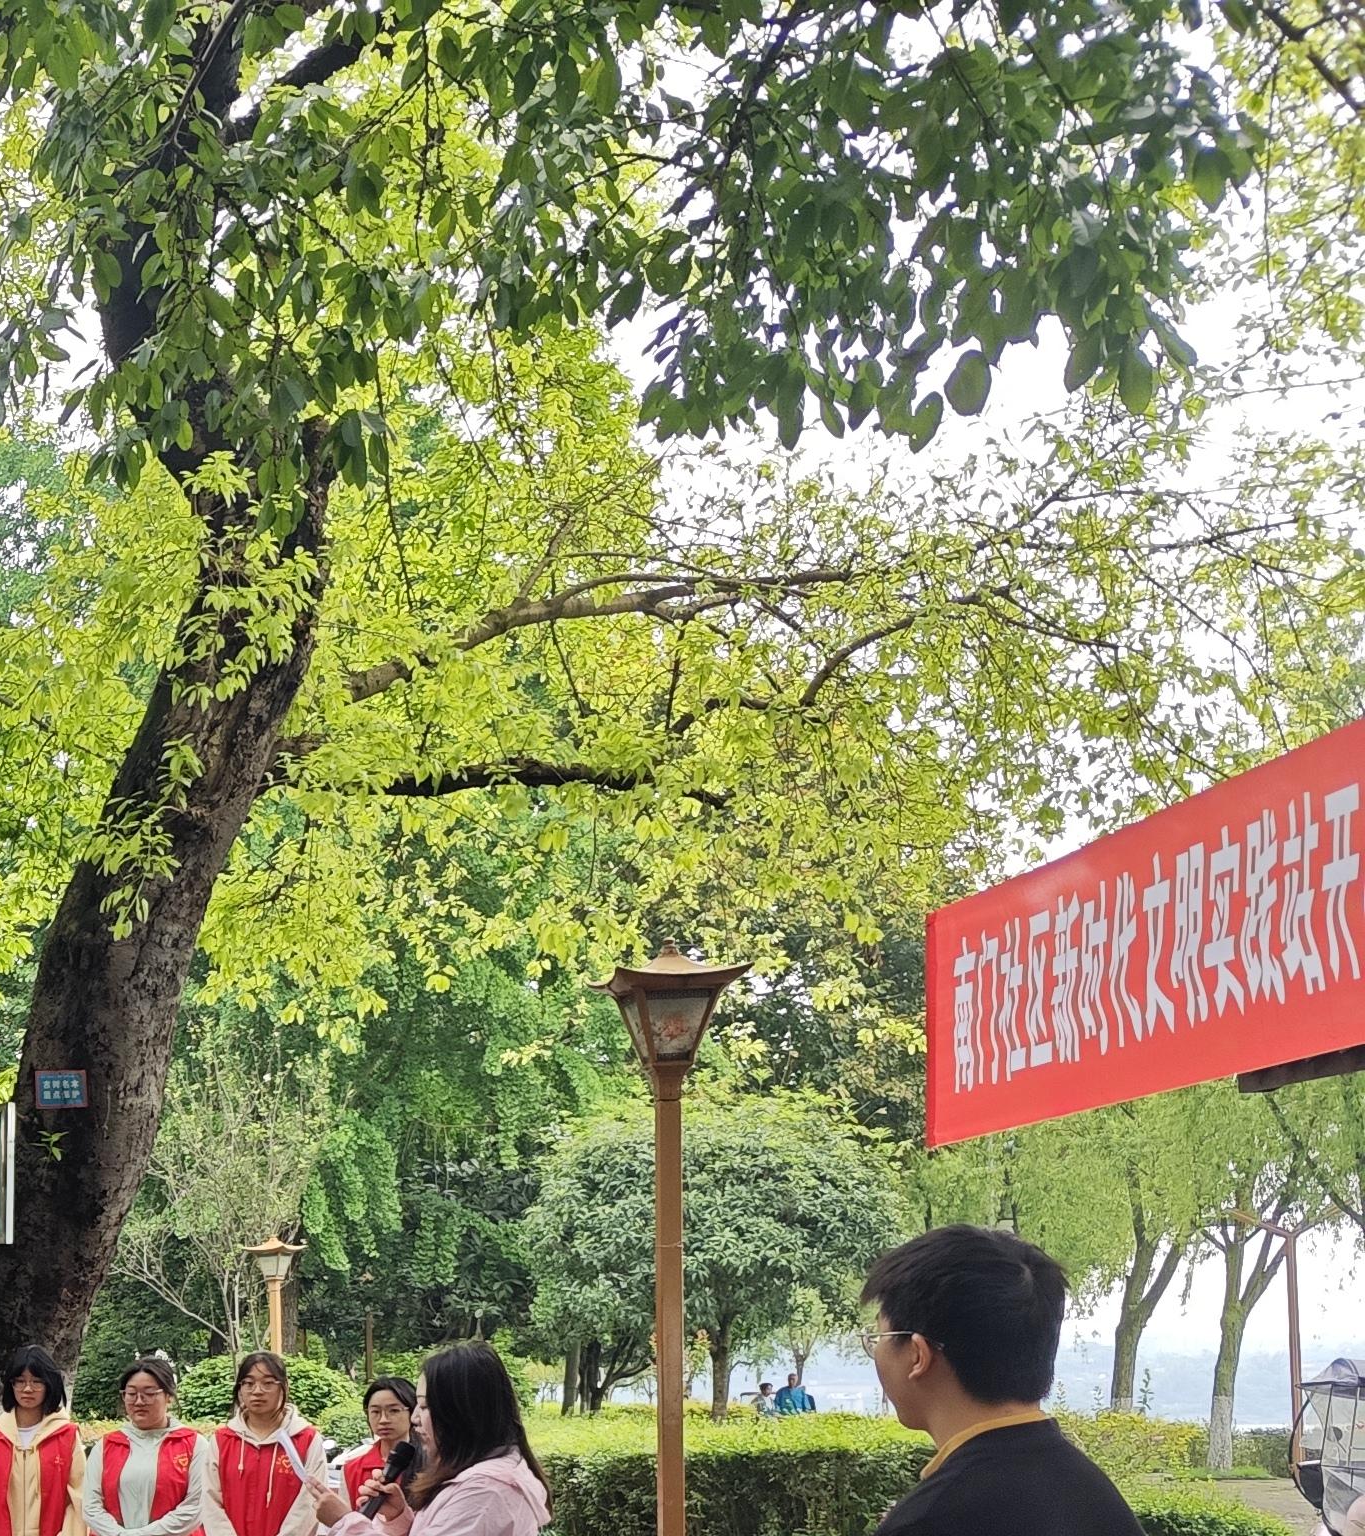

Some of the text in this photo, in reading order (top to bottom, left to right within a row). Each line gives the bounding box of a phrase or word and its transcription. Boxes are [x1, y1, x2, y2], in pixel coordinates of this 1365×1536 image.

[954, 783, 1365, 1094] 南门社区新时代文明实践站开
